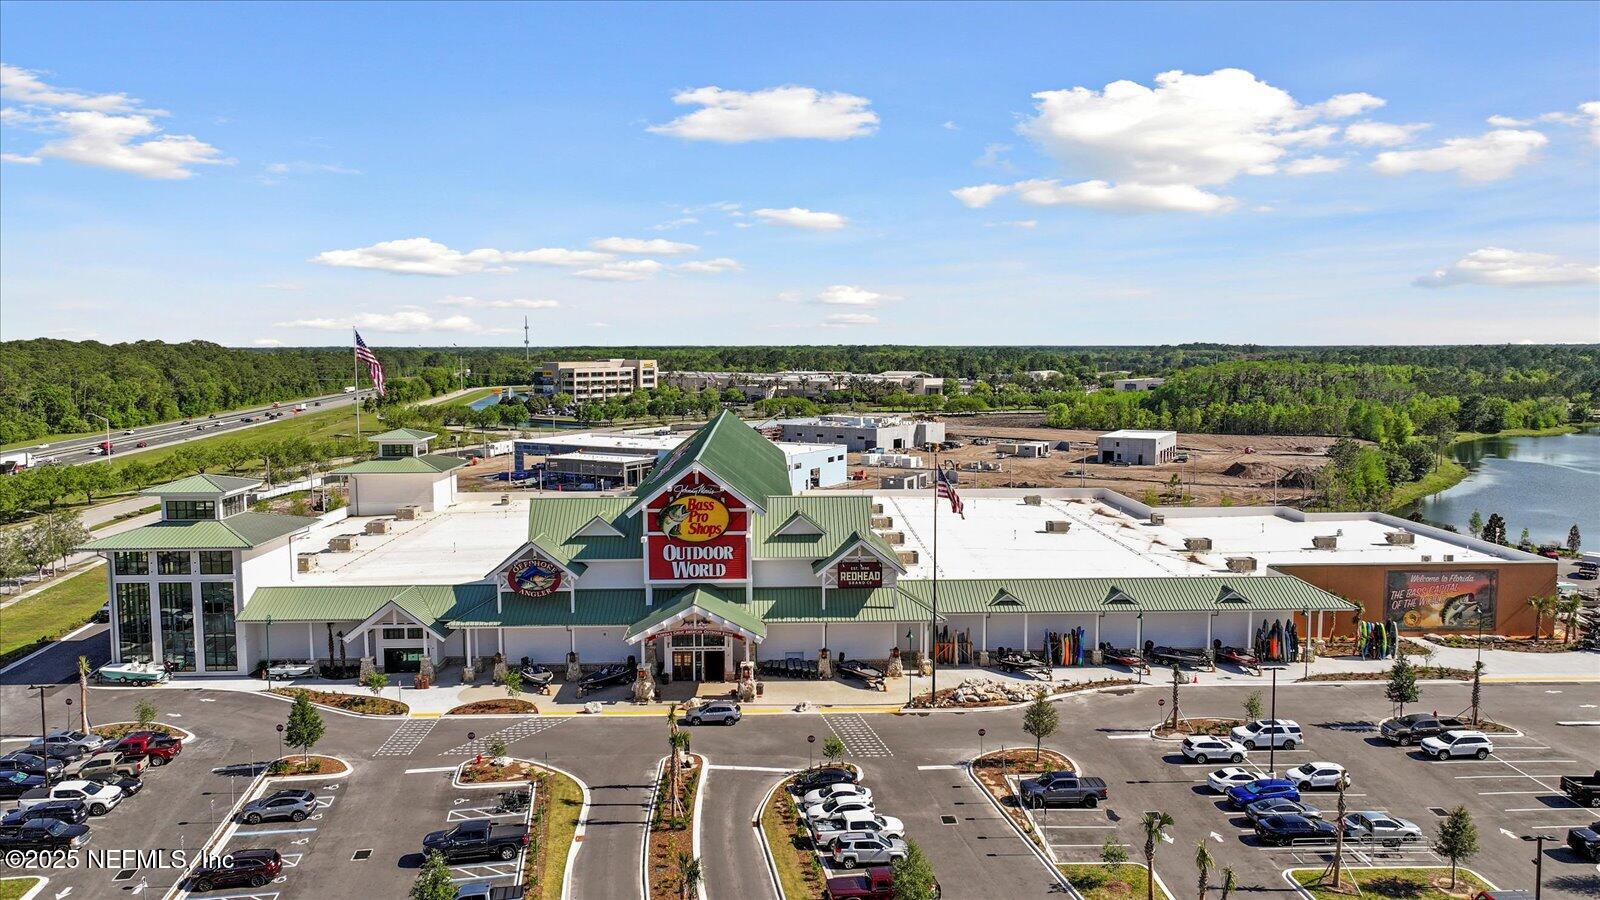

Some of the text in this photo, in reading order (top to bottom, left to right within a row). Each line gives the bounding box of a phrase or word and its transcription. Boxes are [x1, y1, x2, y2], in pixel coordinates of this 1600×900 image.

[687, 498, 715, 511] Bass
[688, 511, 709, 522] Pro
[688, 523, 722, 537] Shops
[663, 544, 734, 561] OUTDOOR
[671, 562, 727, 578] WORLD
[840, 571, 880, 580] REDHEAD
[1410, 574, 1440, 583] Welcome
[1449, 574, 1474, 582] Florida
[519, 588, 551, 597] ANGLER
[1390, 583, 1459, 600] THE BASS CAPITAL
[1391, 600, 1401, 610] OF
